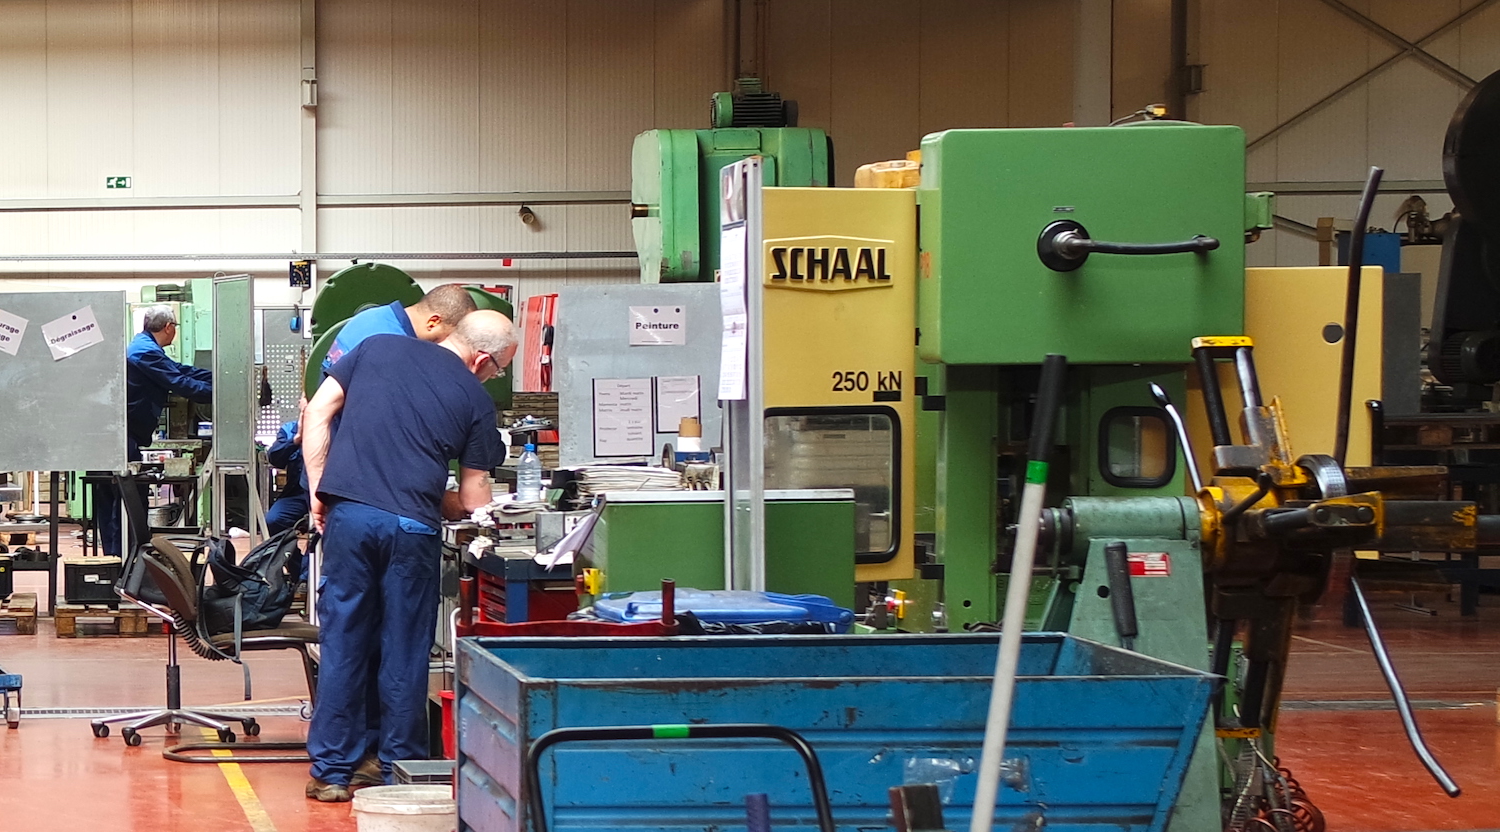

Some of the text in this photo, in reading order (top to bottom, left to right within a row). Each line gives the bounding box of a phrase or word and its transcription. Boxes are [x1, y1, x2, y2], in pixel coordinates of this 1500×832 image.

[770, 247, 891, 282] SCHAAL
[635, 321, 680, 331] Peinture
[832, 370, 902, 392] 250 kN
